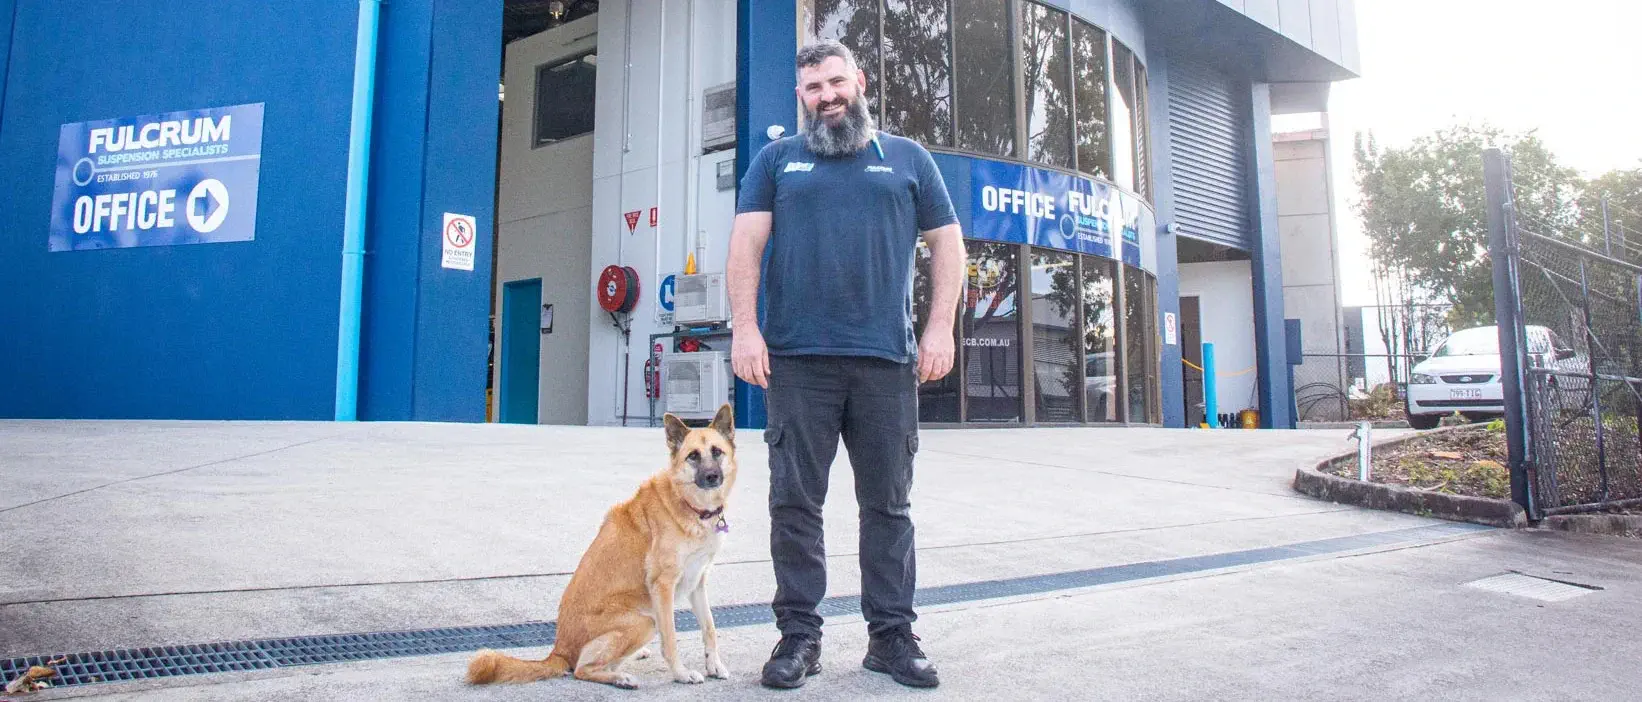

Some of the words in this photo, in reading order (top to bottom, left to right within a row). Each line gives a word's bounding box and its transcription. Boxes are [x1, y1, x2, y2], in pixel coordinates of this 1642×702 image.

[88, 115, 232, 153] FULCRUM
[98, 151, 160, 165] SUSPENSION
[162, 144, 229, 159] SPECIALISTS
[97, 171, 141, 183] ESTABLISHED
[73, 189, 177, 234] OFFICE
[982, 185, 1055, 220] OFFICE
